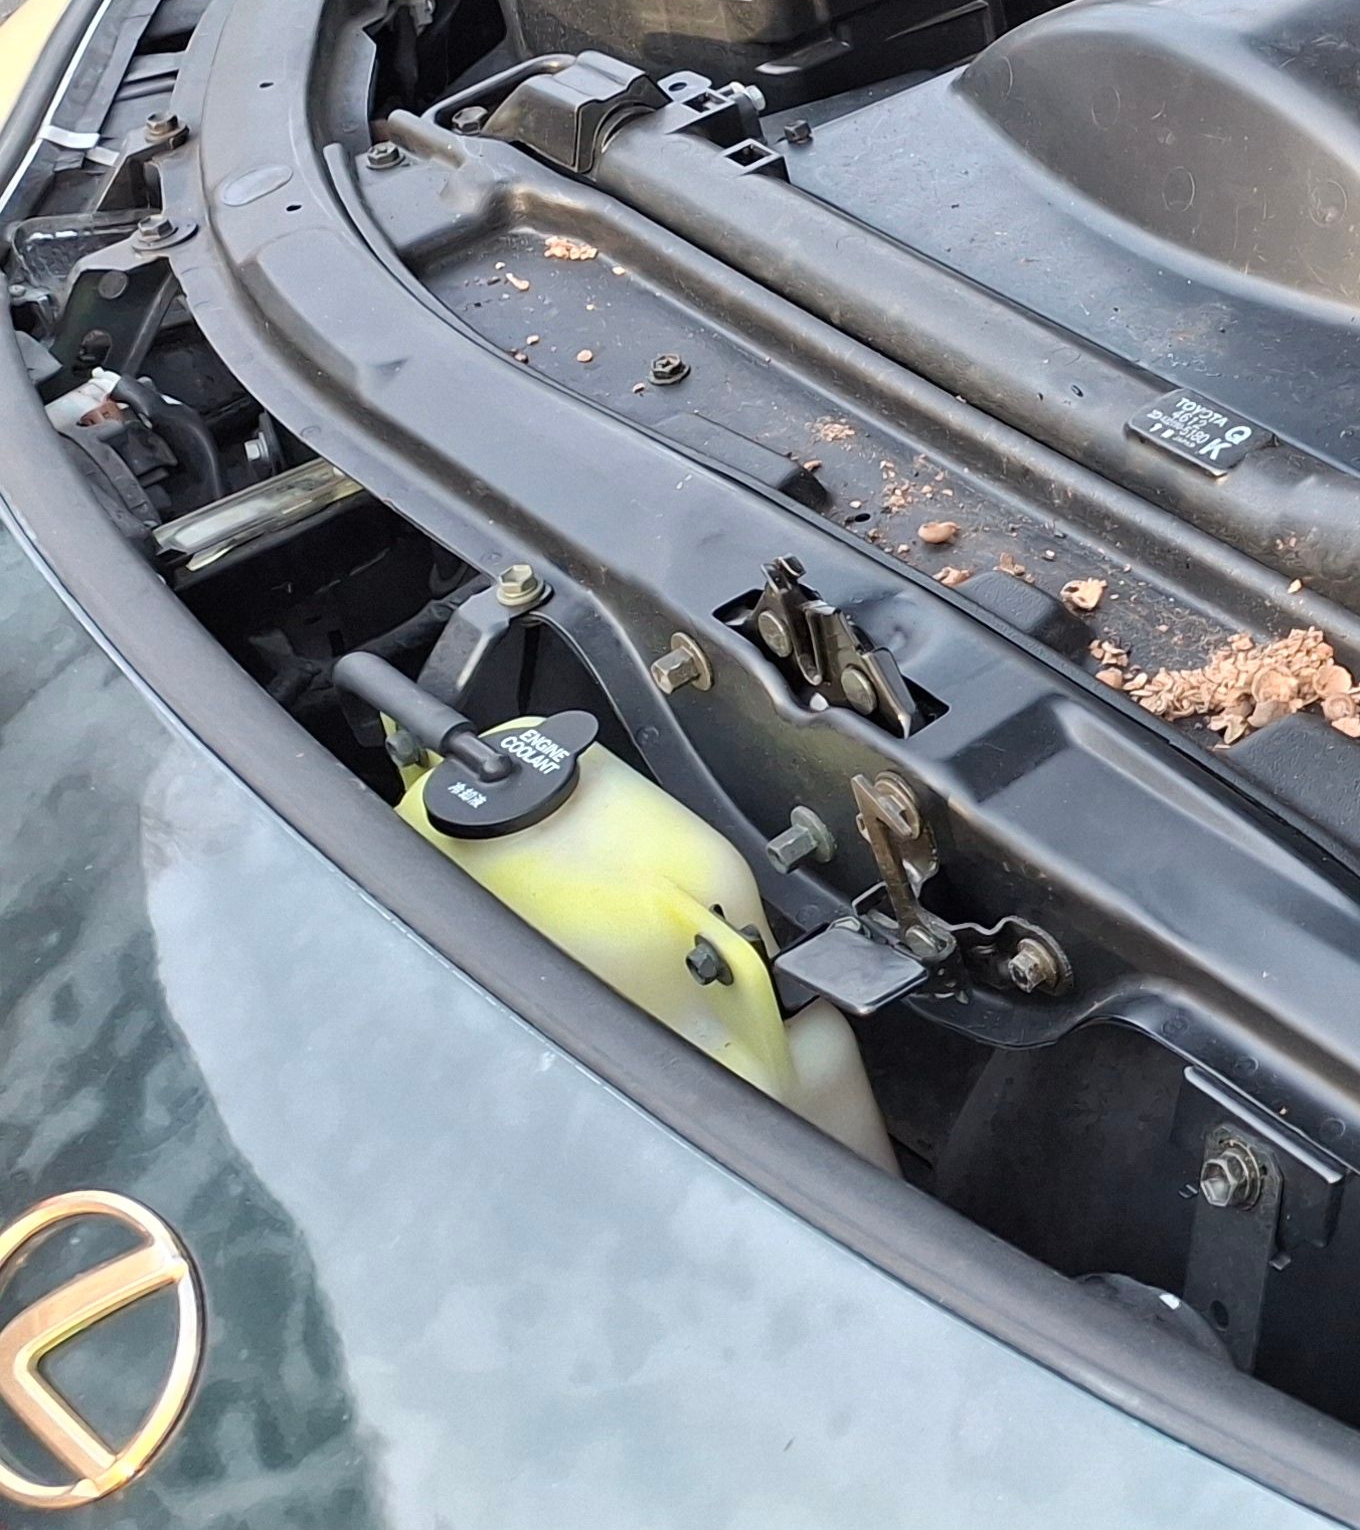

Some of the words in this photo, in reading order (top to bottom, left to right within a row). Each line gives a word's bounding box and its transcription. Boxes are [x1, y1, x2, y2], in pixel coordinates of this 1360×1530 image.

[1176, 397, 1228, 428] TOYOTA
[1224, 425, 1252, 446] Q
[1199, 438, 1232, 461] K
[500, 735, 561, 775] COOLANT
[519, 729, 570, 763] ENGINE
